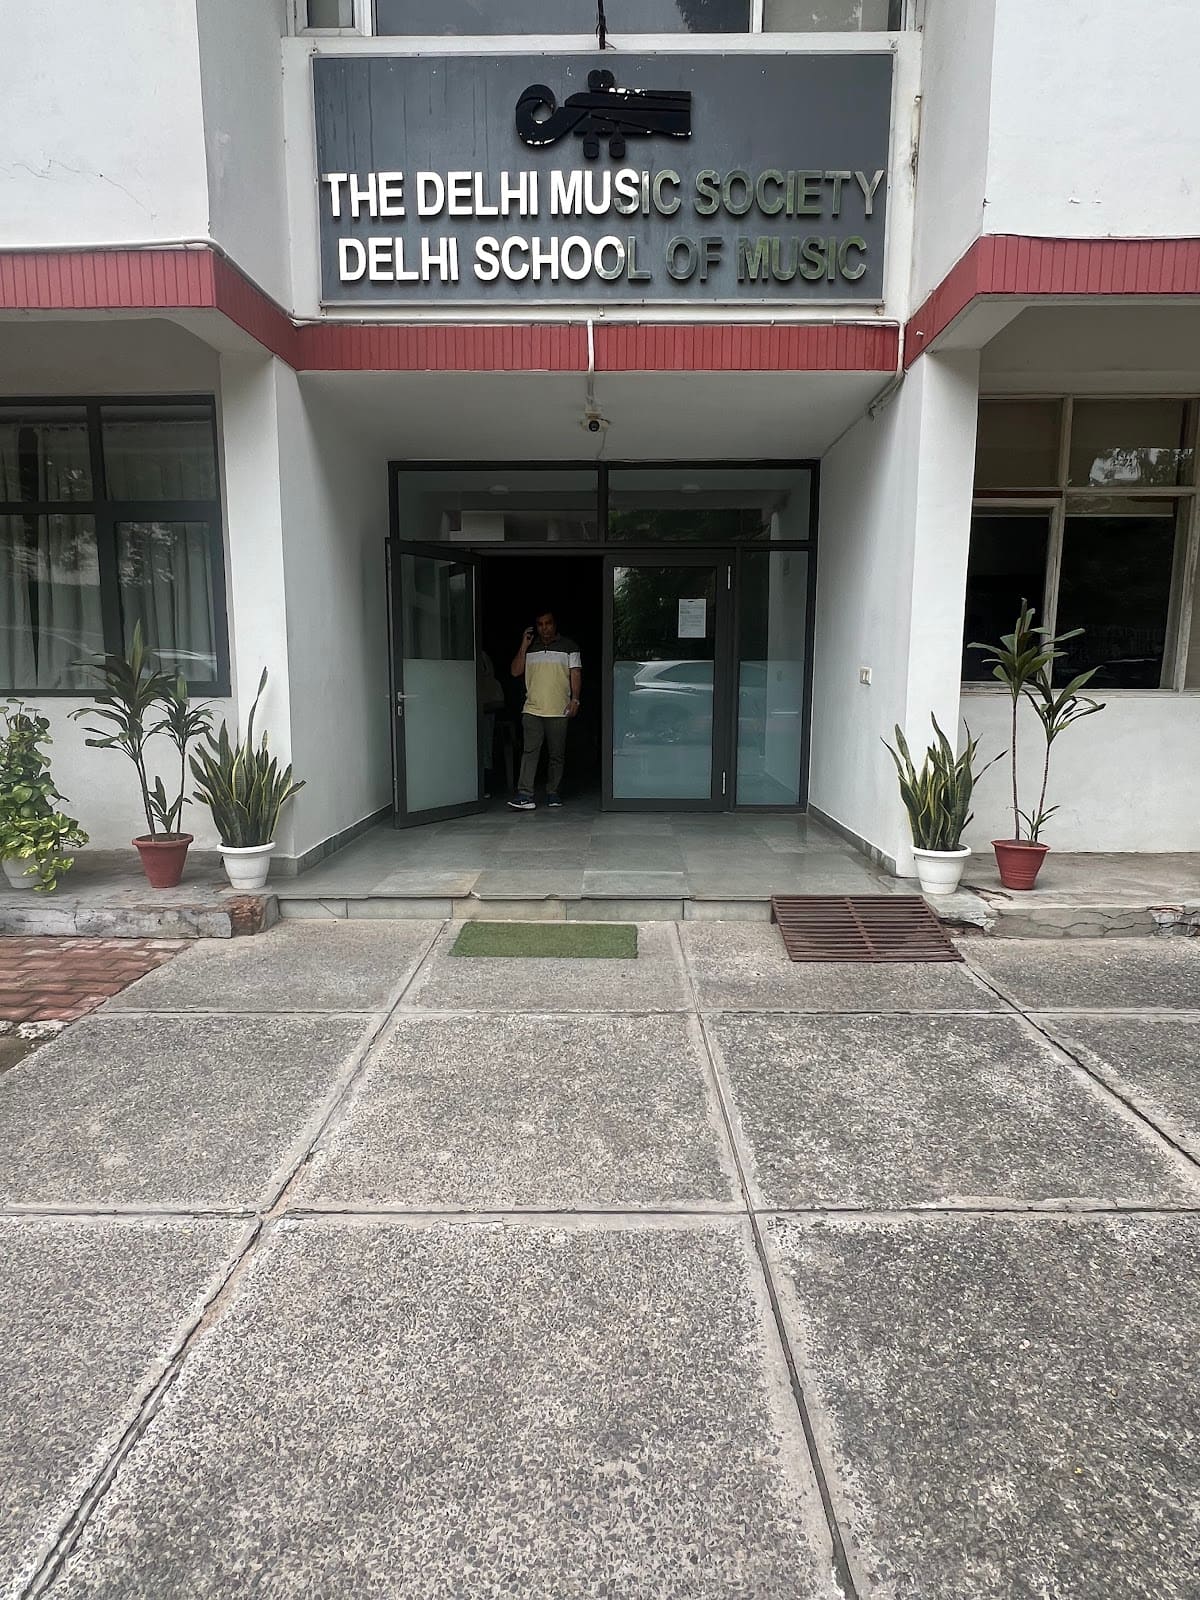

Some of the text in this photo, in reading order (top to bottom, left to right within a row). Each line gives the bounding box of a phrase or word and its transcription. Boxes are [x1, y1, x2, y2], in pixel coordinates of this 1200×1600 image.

[322, 169, 884, 217] THE DELHI MUSIC SOCIETY
[338, 235, 867, 282] DELHI SCHOOL OF MUSIC
